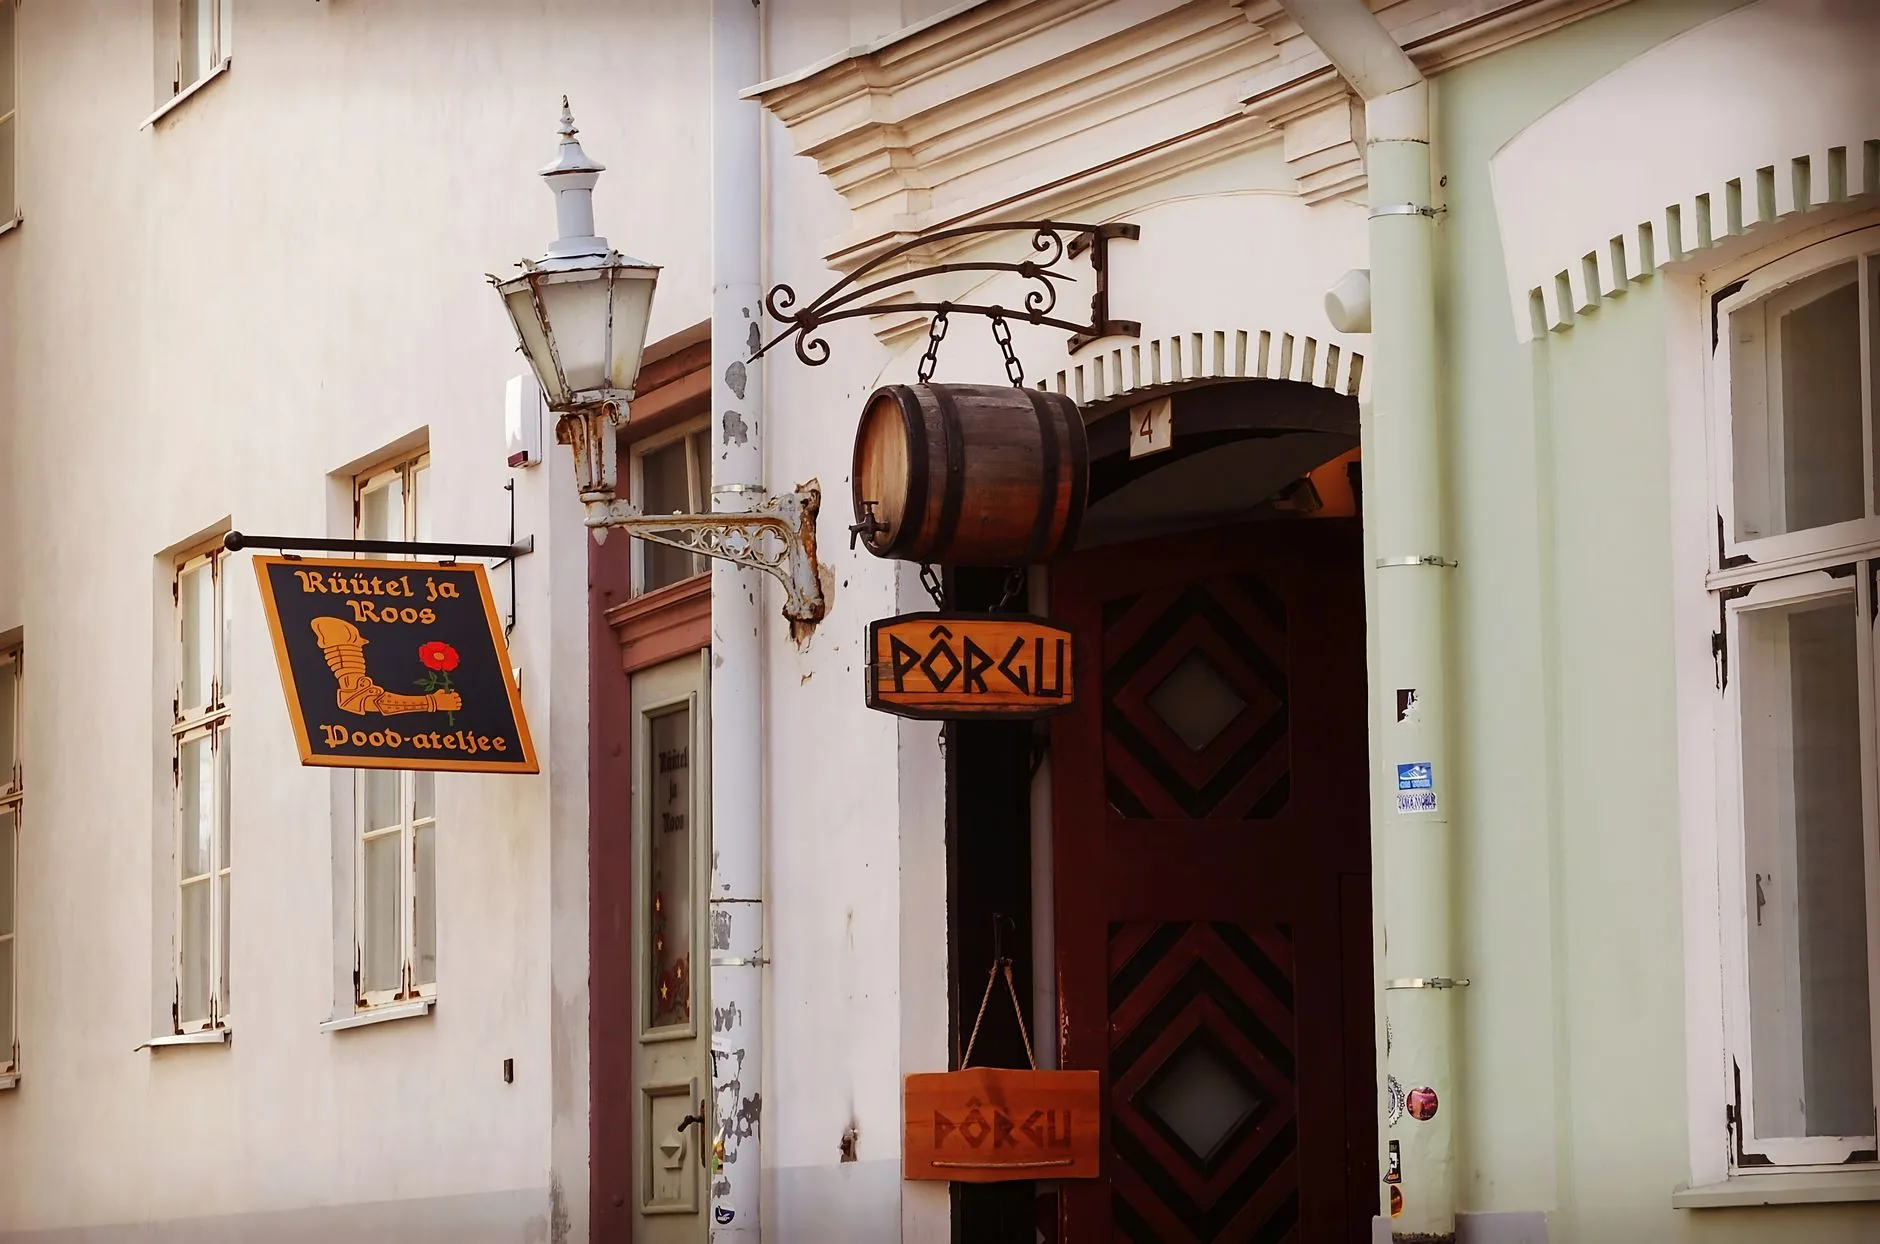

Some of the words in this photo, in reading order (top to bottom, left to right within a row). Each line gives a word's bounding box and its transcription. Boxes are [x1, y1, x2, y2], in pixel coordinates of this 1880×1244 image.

[1140, 409, 1153, 444] 4
[294, 570, 415, 597] Rüütel
[425, 576, 460, 602] ja
[346, 600, 436, 625] Roos
[319, 724, 507, 753] Pood-ateljee
